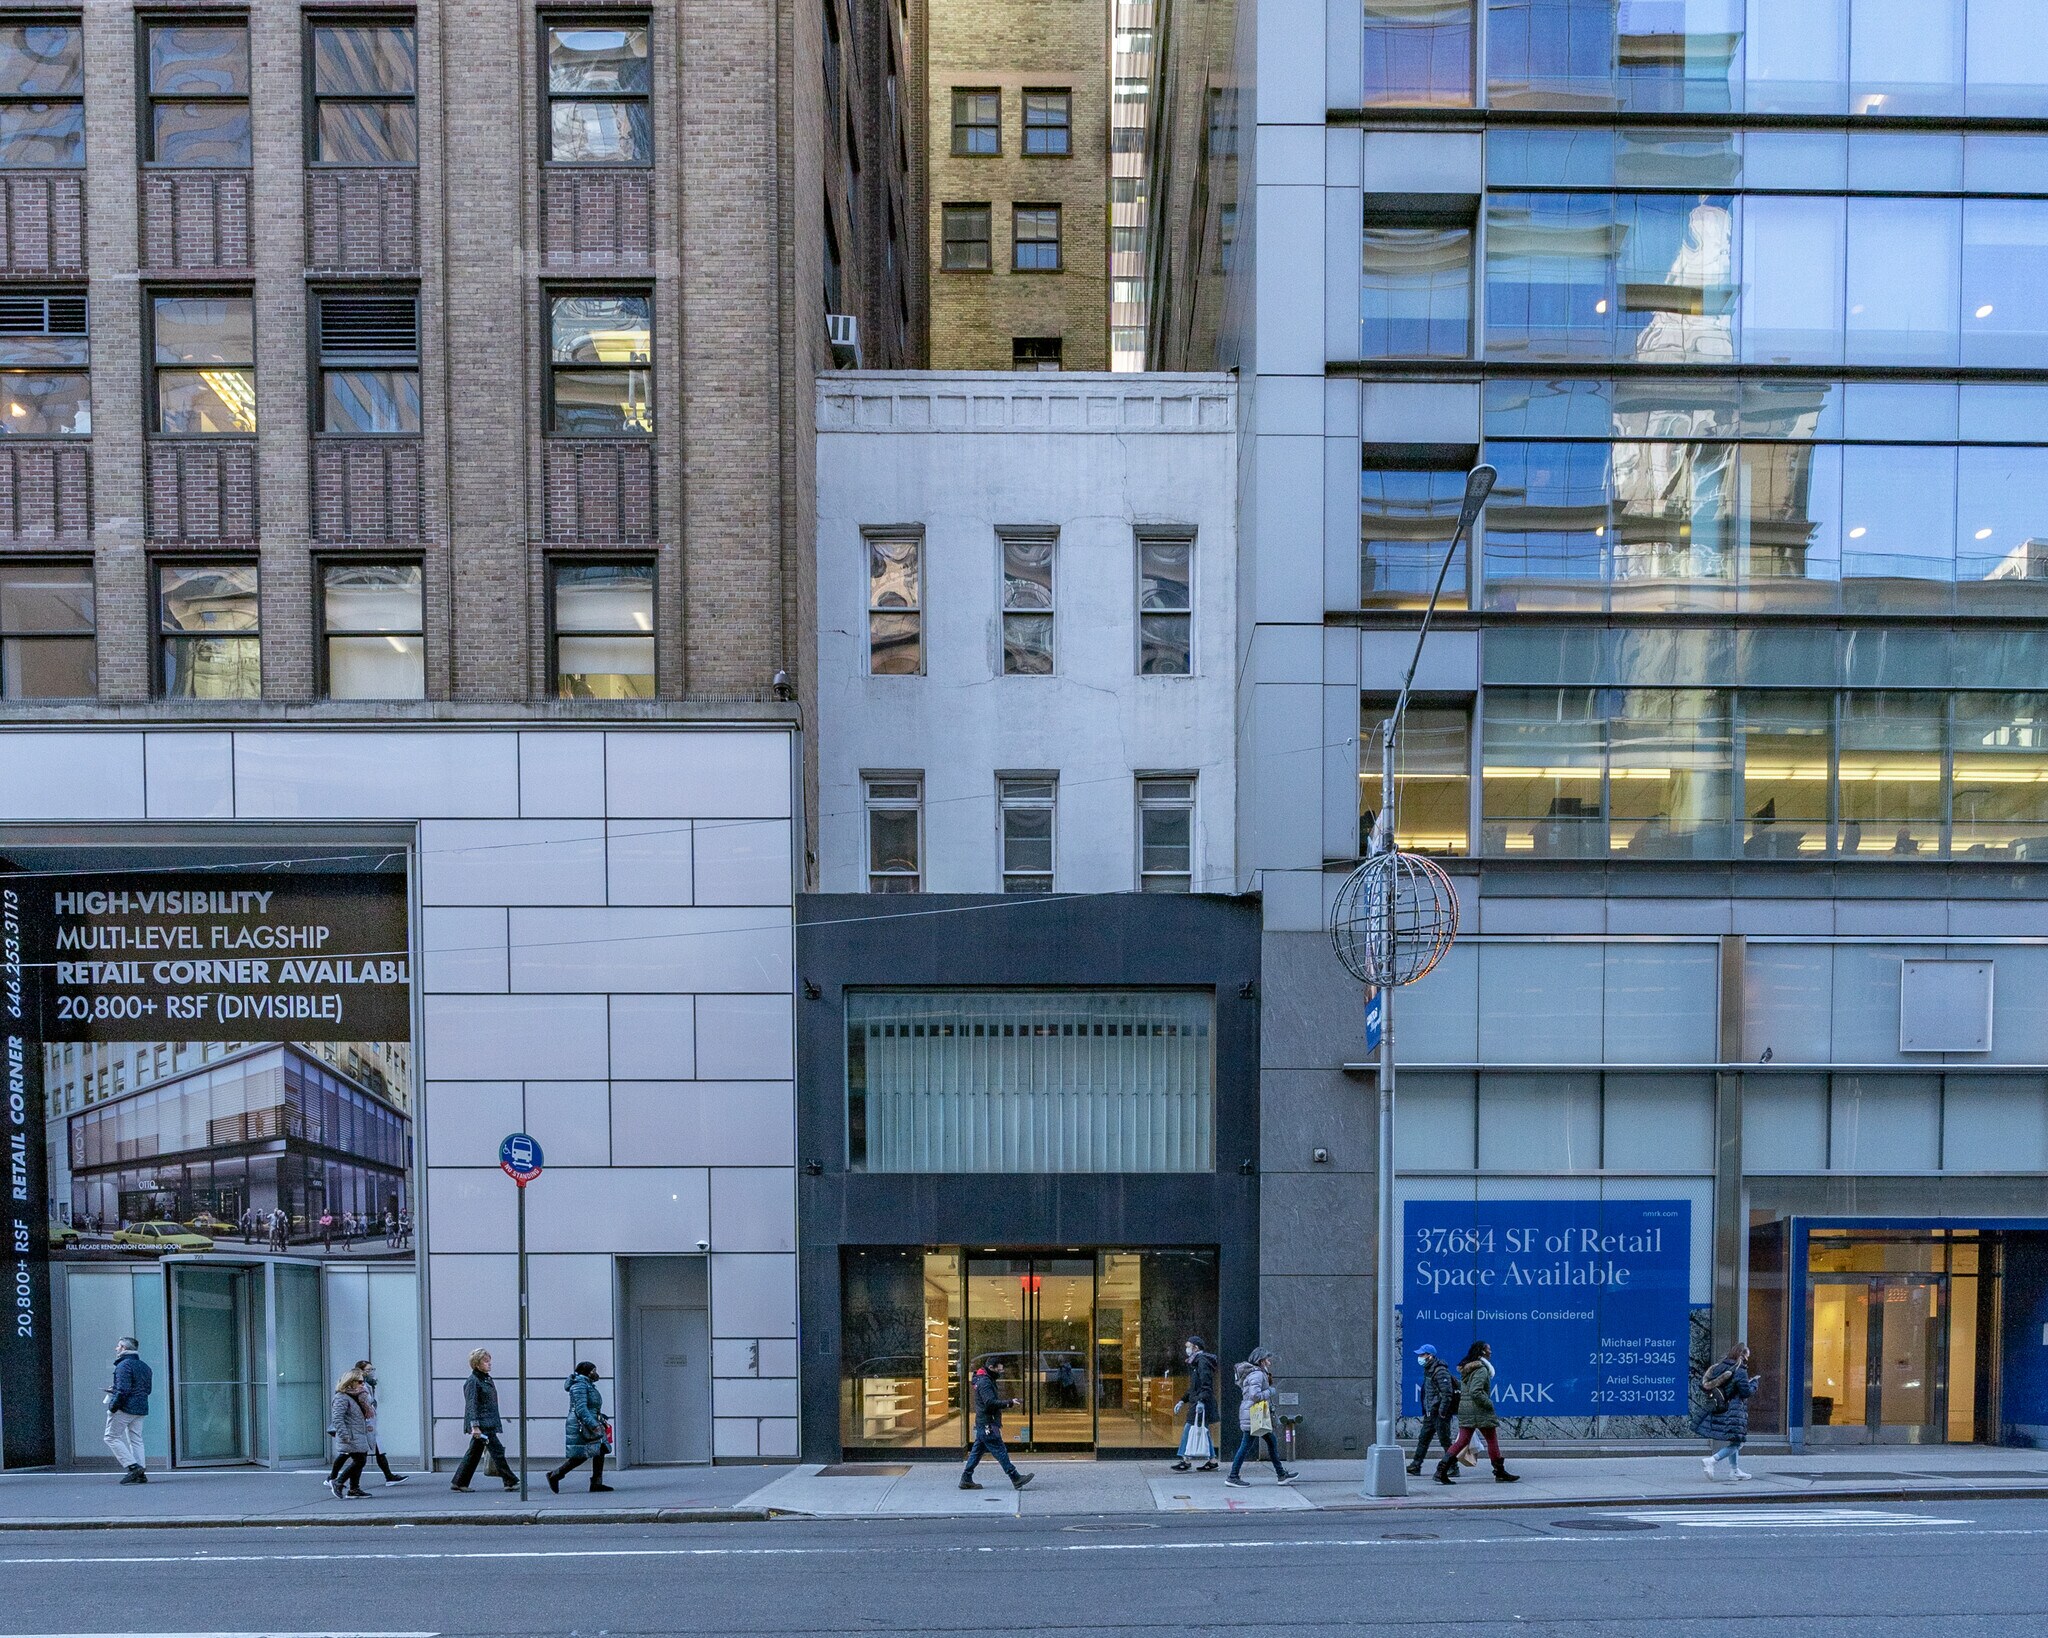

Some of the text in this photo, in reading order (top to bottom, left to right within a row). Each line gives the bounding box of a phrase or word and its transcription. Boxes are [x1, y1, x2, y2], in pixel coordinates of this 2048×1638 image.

[55, 891, 273, 915] HIGH-VISIBILITY
[56, 926, 330, 950] MULTI-LEVEL FLAGSHIP
[56, 960, 410, 985] RETAIL CORNER AVAILABL
[57, 993, 343, 1024] 20,800+ RSF (DIVISIBLE)
[3, 889, 34, 1338] 20,800+ RSF RETAIL CORNER 646.253.3113
[1416, 1228, 1662, 1257] 37,684 SF of Retail
[1416, 1261, 1631, 1294] Space Available
[1416, 1309, 1594, 1323] All Logical Divisions Considered
[1601, 1337, 1676, 1347] Michael Paster
[1589, 1352, 1676, 1365] 212-351-9345
[1606, 1374, 1676, 1385] Ariel Schuster
[1590, 1390, 1676, 1402] 212-331-0132
